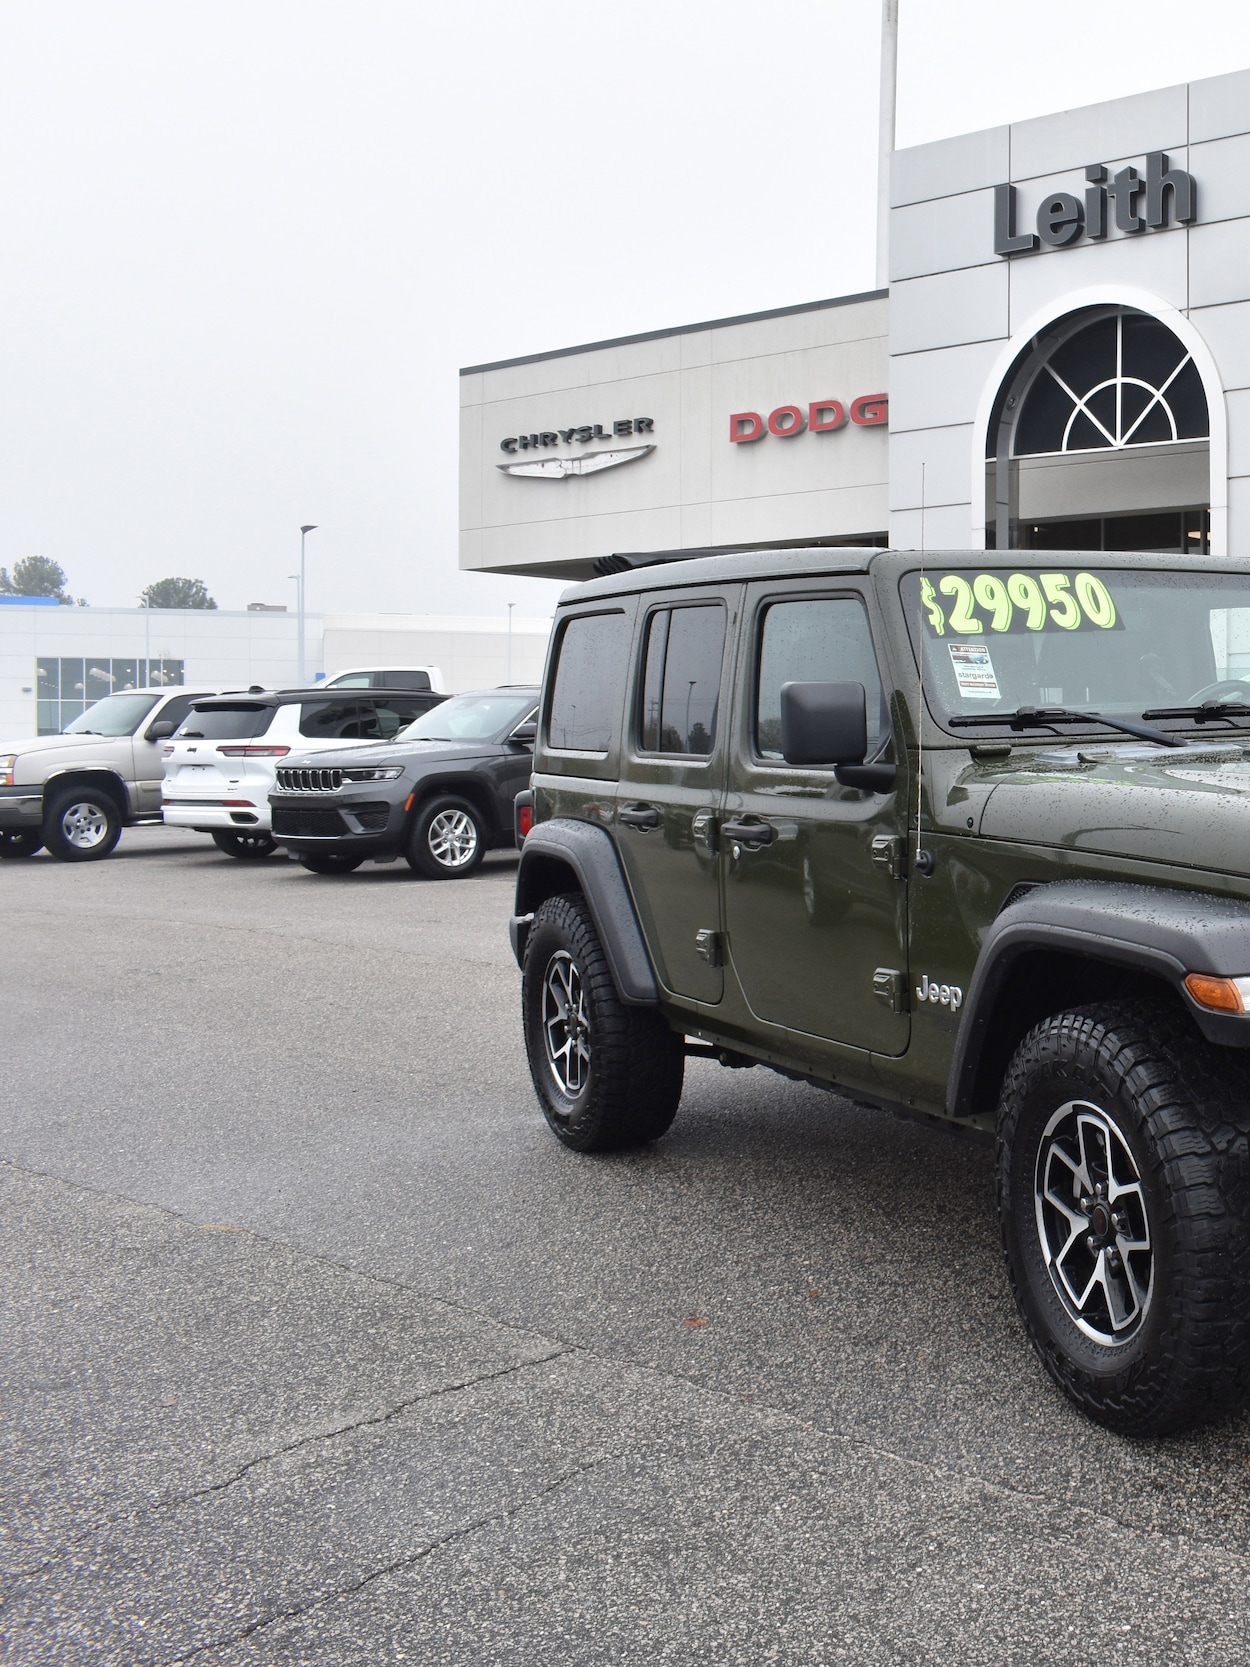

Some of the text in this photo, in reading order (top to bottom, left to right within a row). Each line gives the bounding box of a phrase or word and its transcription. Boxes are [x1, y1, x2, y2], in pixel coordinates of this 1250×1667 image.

[994, 151, 1197, 256] Leith
[501, 417, 655, 453] CHRYSLER
[730, 393, 888, 443] DODG
[920, 572, 1117, 636] $29950
[916, 974, 962, 1012] Jeep
